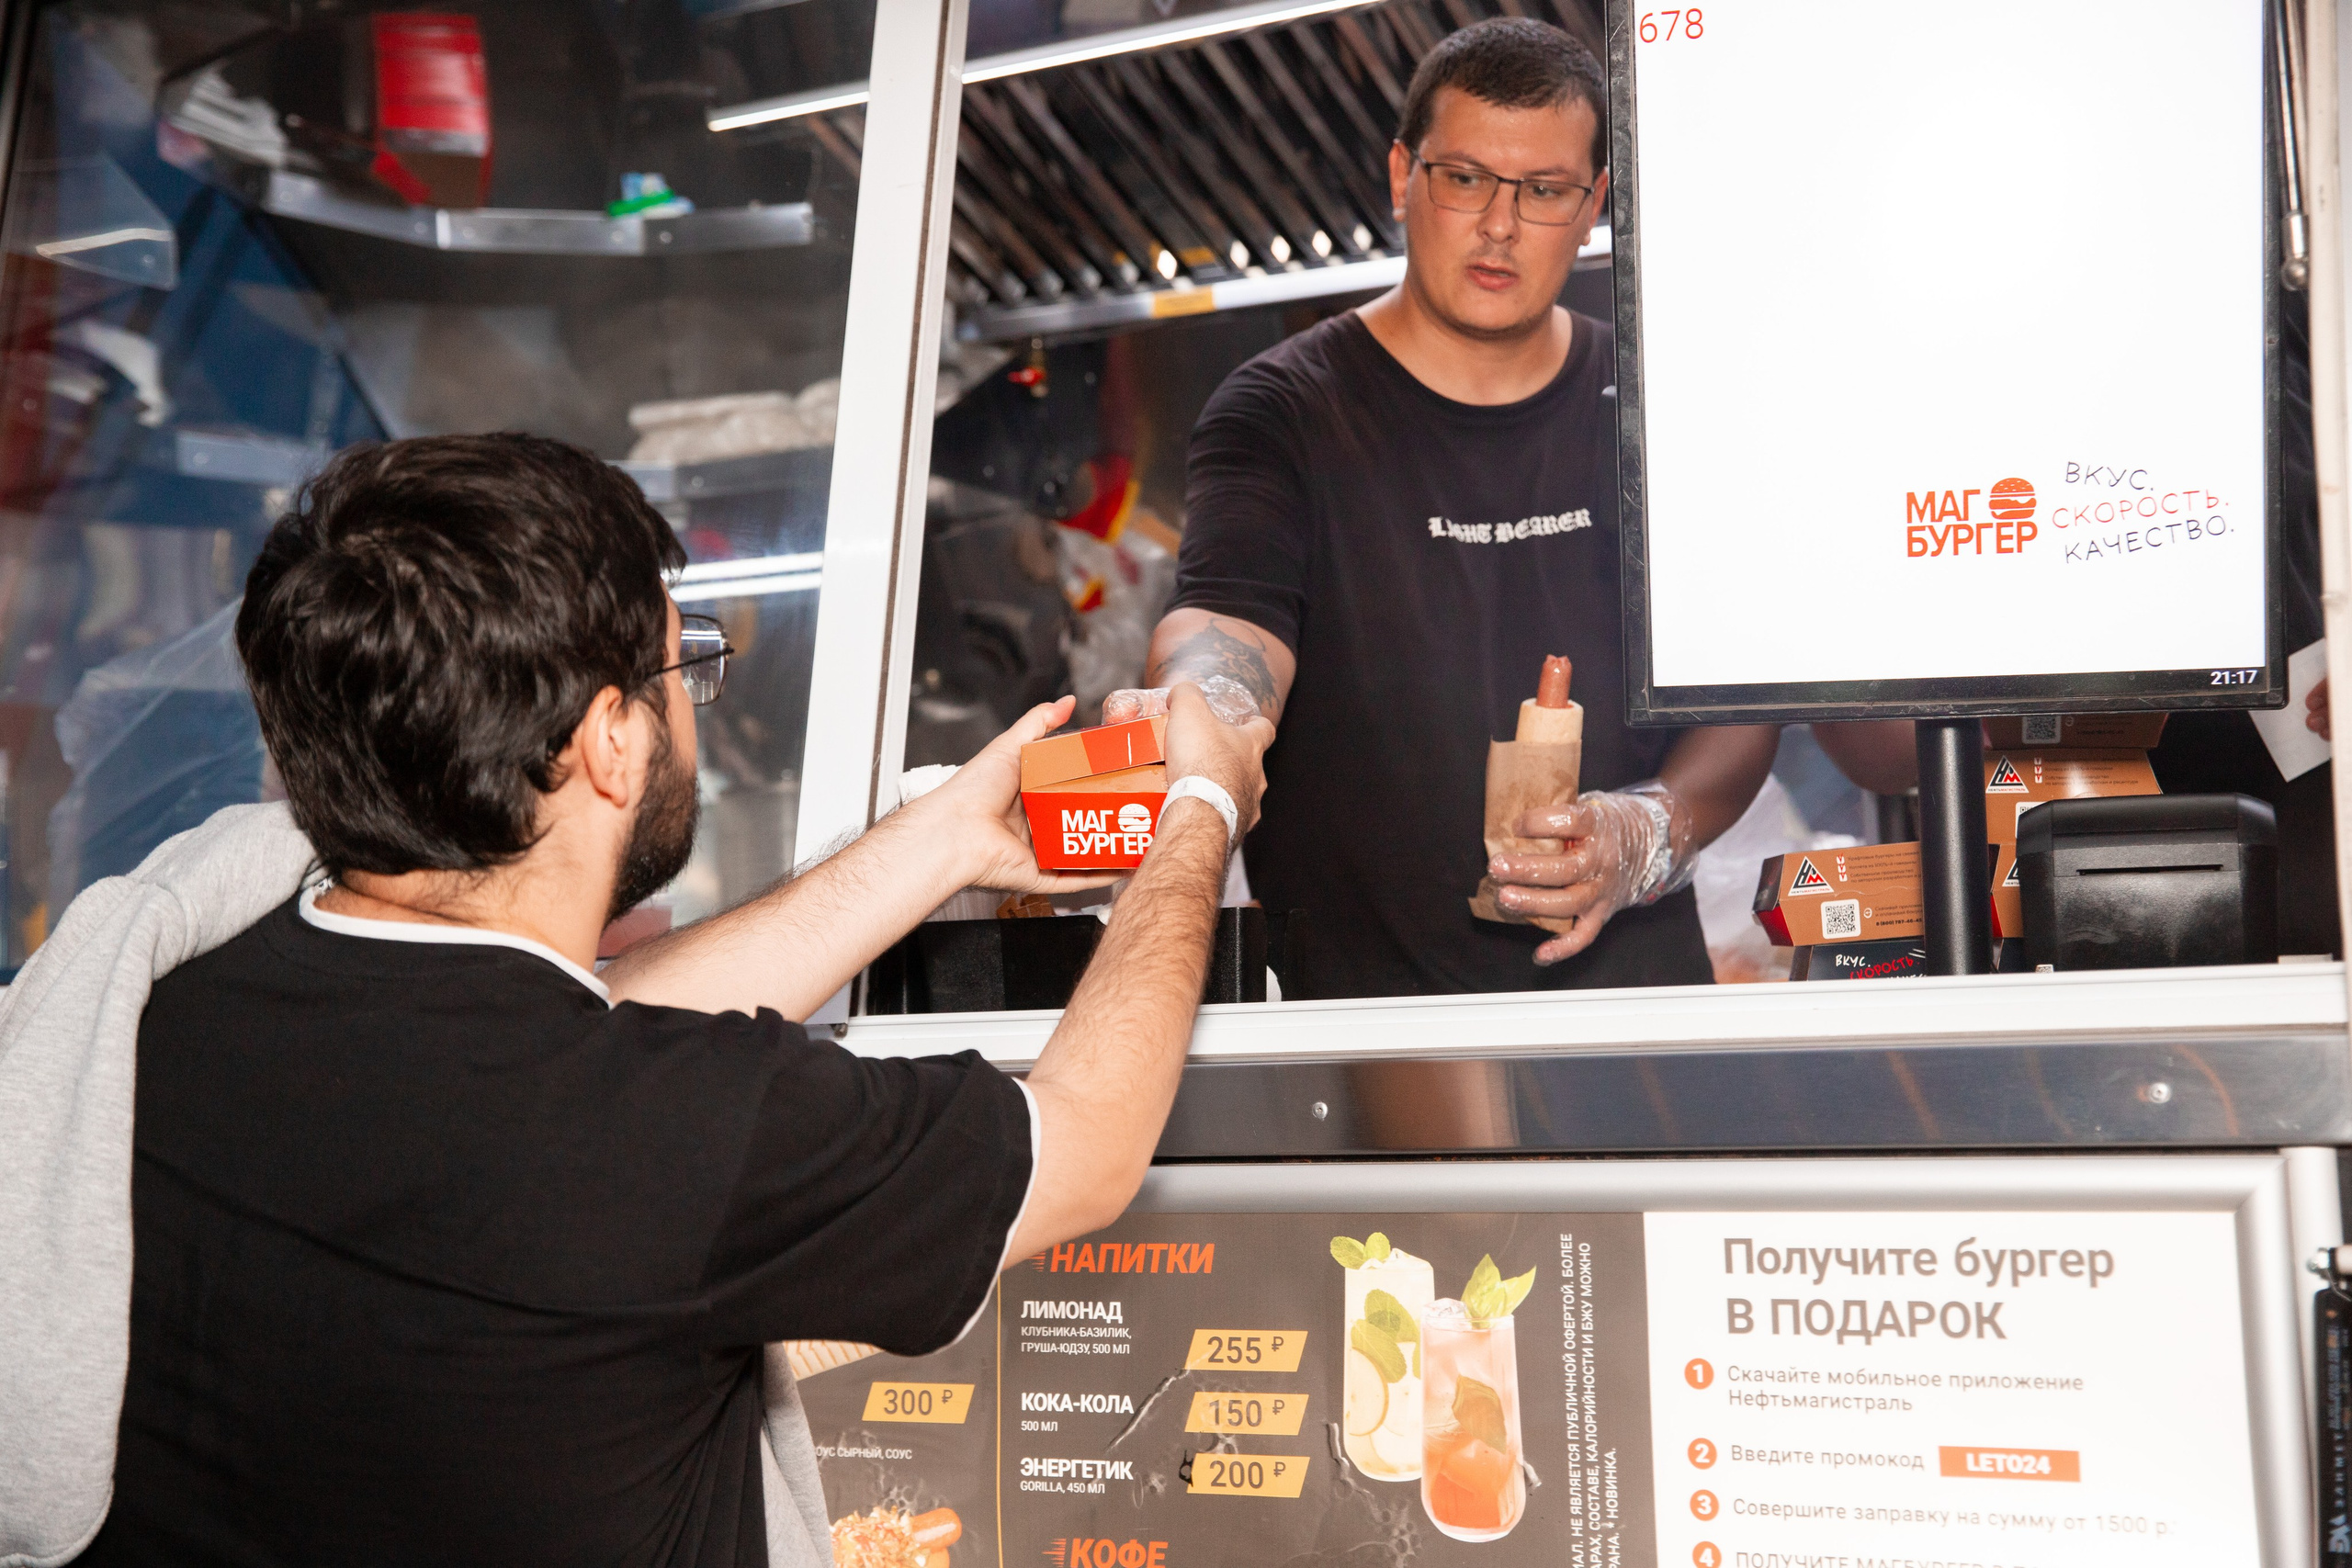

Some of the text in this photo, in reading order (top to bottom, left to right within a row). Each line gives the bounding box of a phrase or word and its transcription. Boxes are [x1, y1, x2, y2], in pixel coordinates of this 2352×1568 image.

[1638, 8, 1704, 44] 678
[2064, 461, 2154, 491] ВКУС.
[1905, 489, 1981, 524] МАГ
[2052, 490, 2230, 529] СКОРОСТЬ.
[1906, 521, 2038, 558] БУРГЕР
[2064, 515, 2234, 564] КАЧЕСТВО.
[2210, 670, 2257, 686] 21:17
[1061, 809, 1114, 832] МАГ
[1063, 832, 1154, 855] БУРГЕР
[1835, 953, 1871, 967] ВКУС.
[1050, 1243, 1216, 1275] НАПИТКИ
[1561, 1234, 1574, 1278] БОЛЕЕ
[1579, 1243, 1592, 1297] МОЖНО
[1723, 1237, 2116, 1287] Получите бургер
[1021, 1301, 1124, 1324] ЛИМОНАД
[1562, 1281, 1577, 1350] ОФЕРТОЙ.
[1582, 1300, 1594, 1331] БЖУ
[1725, 1297, 2007, 1346] В ПОДАРОК
[1021, 1325, 1133, 1340] КЛУБНИКА-БАЗИЛИК,
[1583, 1335, 1595, 1344] И
[1021, 1342, 1131, 1357] ГРУША-ЮДЗУ, 500 МЛ
[1206, 1335, 1263, 1365] 255
[1727, 1365, 1821, 1383] Скачайте
[1827, 1368, 1942, 1387] мобильное
[1949, 1372, 2084, 1392] приложение
[882, 1387, 933, 1416] 300
[1021, 1393, 1135, 1415] КОКА-КОЛА
[1564, 1353, 1580, 1440] ПУБЛИЧНОЙ
[1581, 1348, 1600, 1462] КАЛОРИЙНОСТИ
[1728, 1389, 1913, 1414] Нефтьмагистраль
[1021, 1421, 1058, 1432] 500 МЛ
[1208, 1398, 1264, 1428] 150
[815, 1446, 912, 1460] ОУС СЫРНЫЙ, СОУС
[1731, 1444, 1815, 1466] Введите
[1820, 1450, 1925, 1471] промокод
[1965, 1450, 2052, 1476] LETO24
[1020, 1458, 1134, 1482] ЭНЕРГЕТИК
[1209, 1460, 1265, 1490] 200
[1566, 1444, 1583, 1515] ЯВЛЯЕТСЯ
[1603, 1448, 1619, 1519] НОВИНКА.
[1020, 1481, 1105, 1495] GORILLA, 450 МЛ
[1587, 1464, 1602, 1531] СОСТАВЕ,
[1570, 1518, 1583, 1537] НЕ
[1733, 1498, 1848, 1521] Совершите
[1853, 1505, 1950, 1528] заправку
[1957, 1509, 1981, 1525] на
[1987, 1513, 2056, 1531] сумму
[2064, 1516, 2086, 1531] от
[2095, 1515, 2148, 1534] 1500
[1069, 1538, 1169, 1568] КОФЕ
[1736, 1551, 1849, 1568] ПОЛУЧИТЕ
